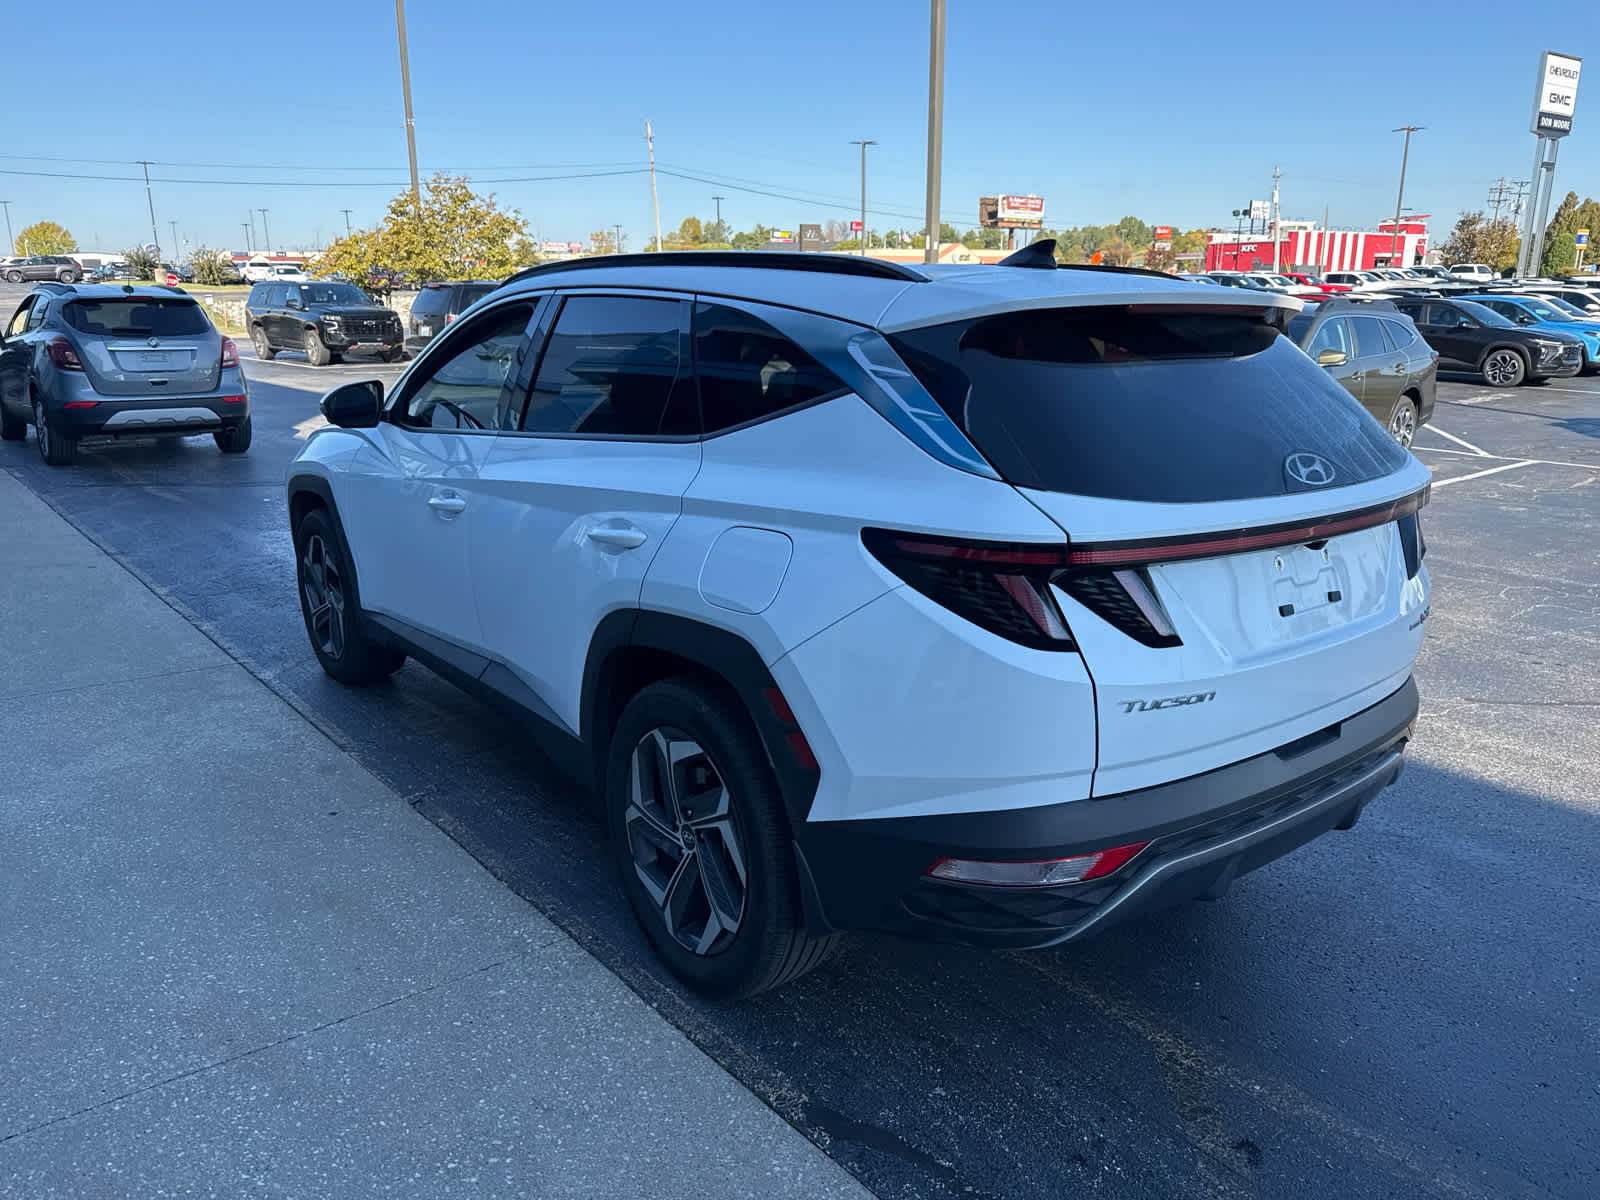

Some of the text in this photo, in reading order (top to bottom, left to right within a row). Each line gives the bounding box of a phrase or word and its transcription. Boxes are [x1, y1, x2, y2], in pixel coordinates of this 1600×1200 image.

[1549, 65, 1578, 79] CHEVROLET
[1549, 93, 1571, 106] GMC
[1541, 117, 1570, 129] DON MOORE
[1241, 244, 1257, 253] KFC
[1118, 690, 1216, 713] TUCSON
